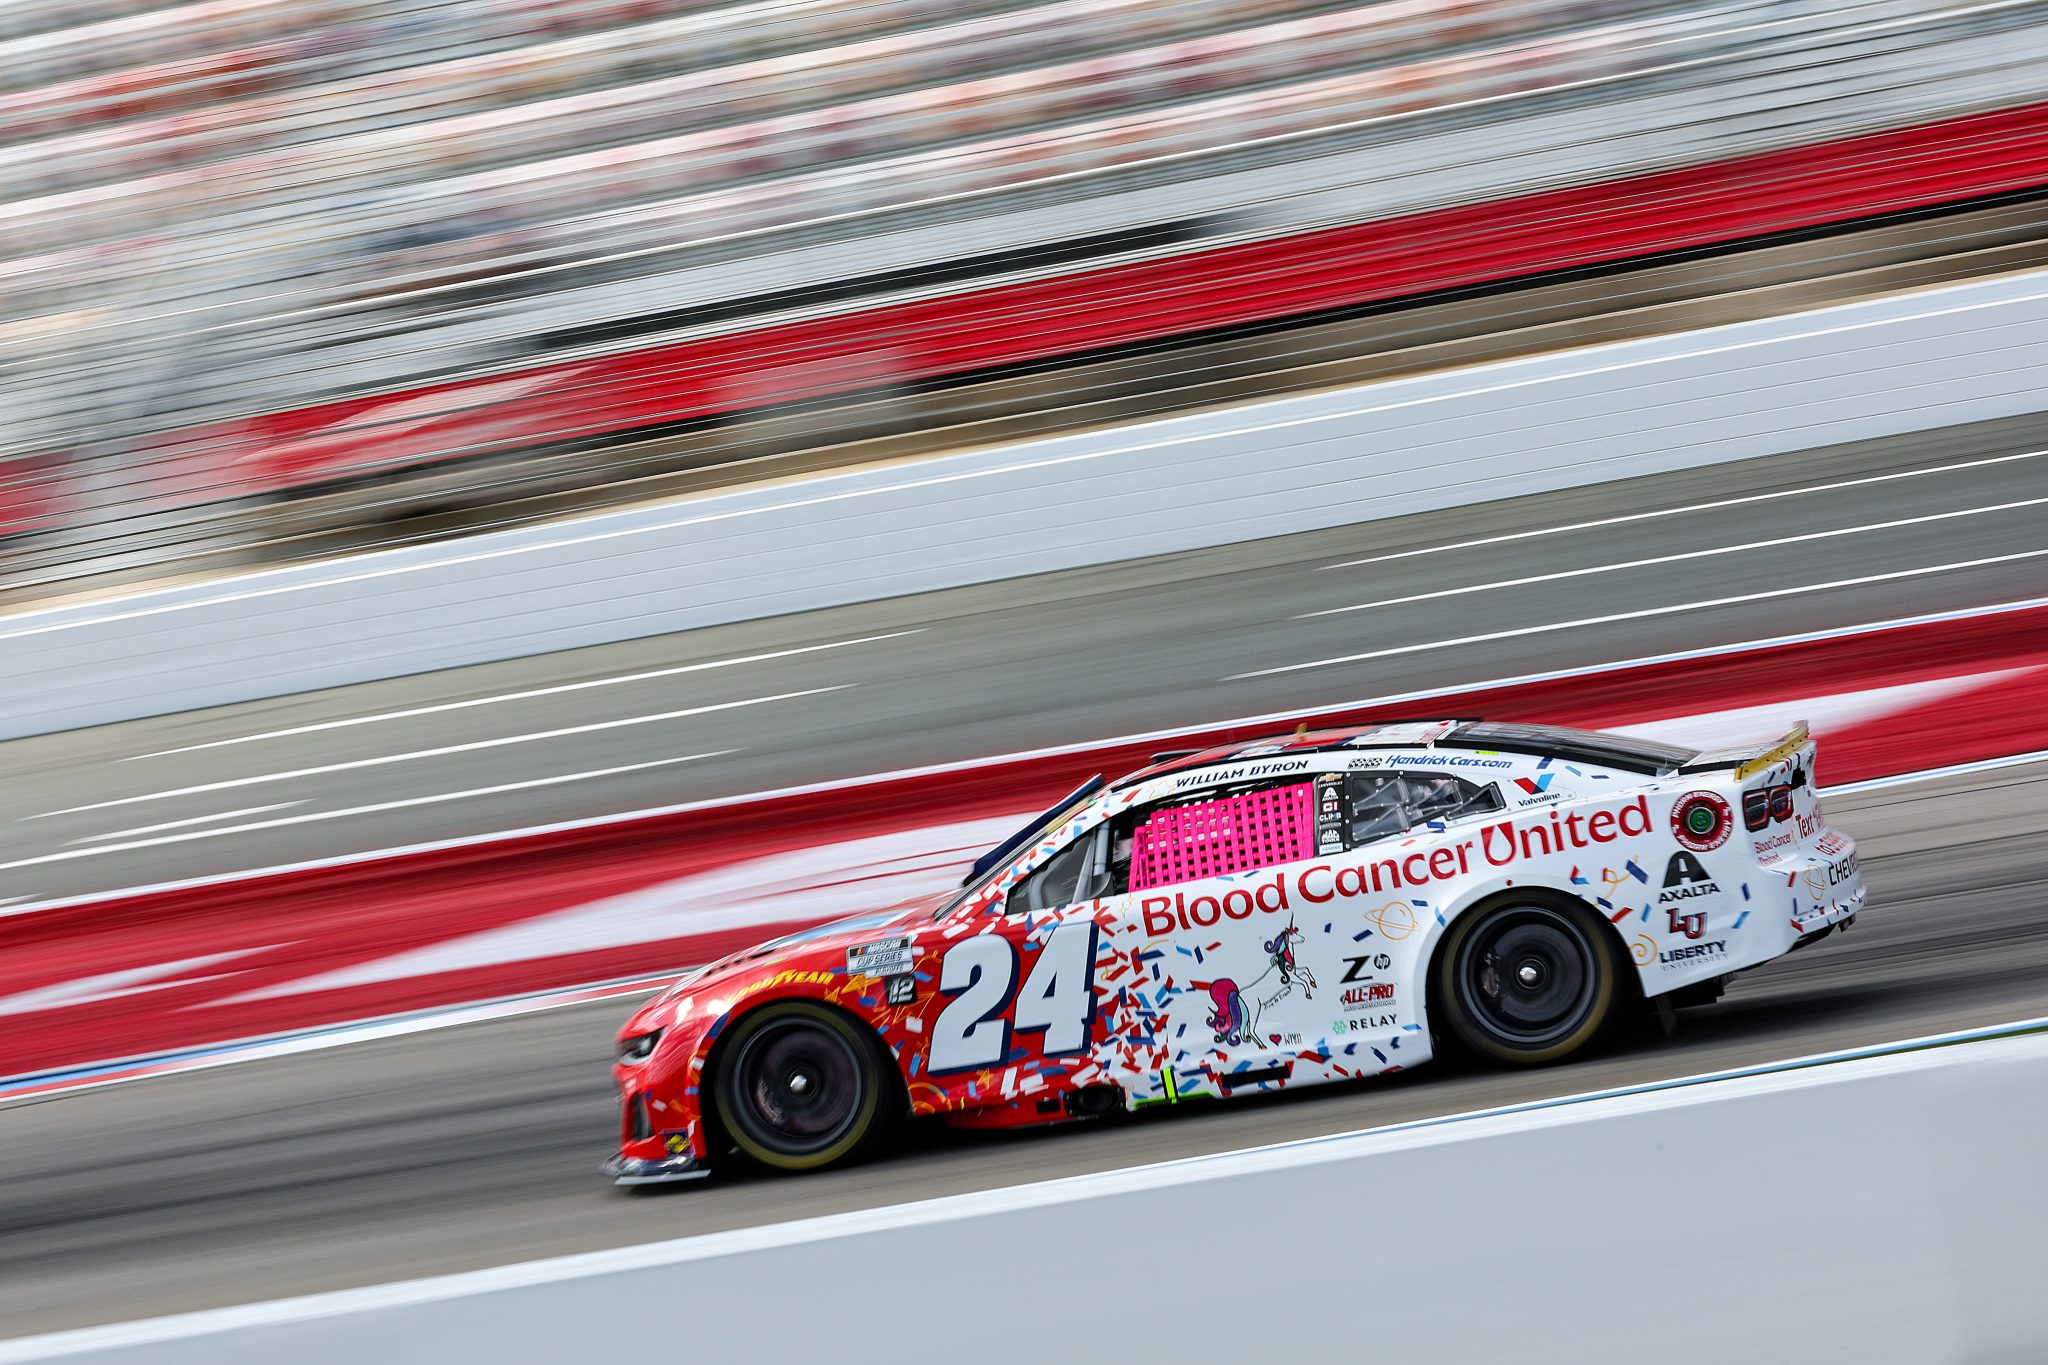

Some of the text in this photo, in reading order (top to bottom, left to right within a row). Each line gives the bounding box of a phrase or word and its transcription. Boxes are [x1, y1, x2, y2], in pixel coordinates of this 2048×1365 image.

[1176, 760, 1309, 788] WILLIAM BYRON
[1517, 792, 1560, 807] Valvoline
[1795, 814, 1814, 839] Text
[1773, 833, 1791, 847] Cancer
[1142, 794, 1653, 938] Blood Cancer United
[1658, 883, 1721, 904] AXALTA
[1666, 908, 1707, 940] LU
[857, 951, 903, 969] CUP SERIES
[1659, 940, 1727, 963] LIBERTY
[1340, 955, 1373, 984] Z
[888, 978, 915, 1004] 12
[927, 920, 1099, 1077] 24
[1343, 984, 1395, 1004] ALL-PRO
[1350, 1014, 1398, 1031] RELAY
